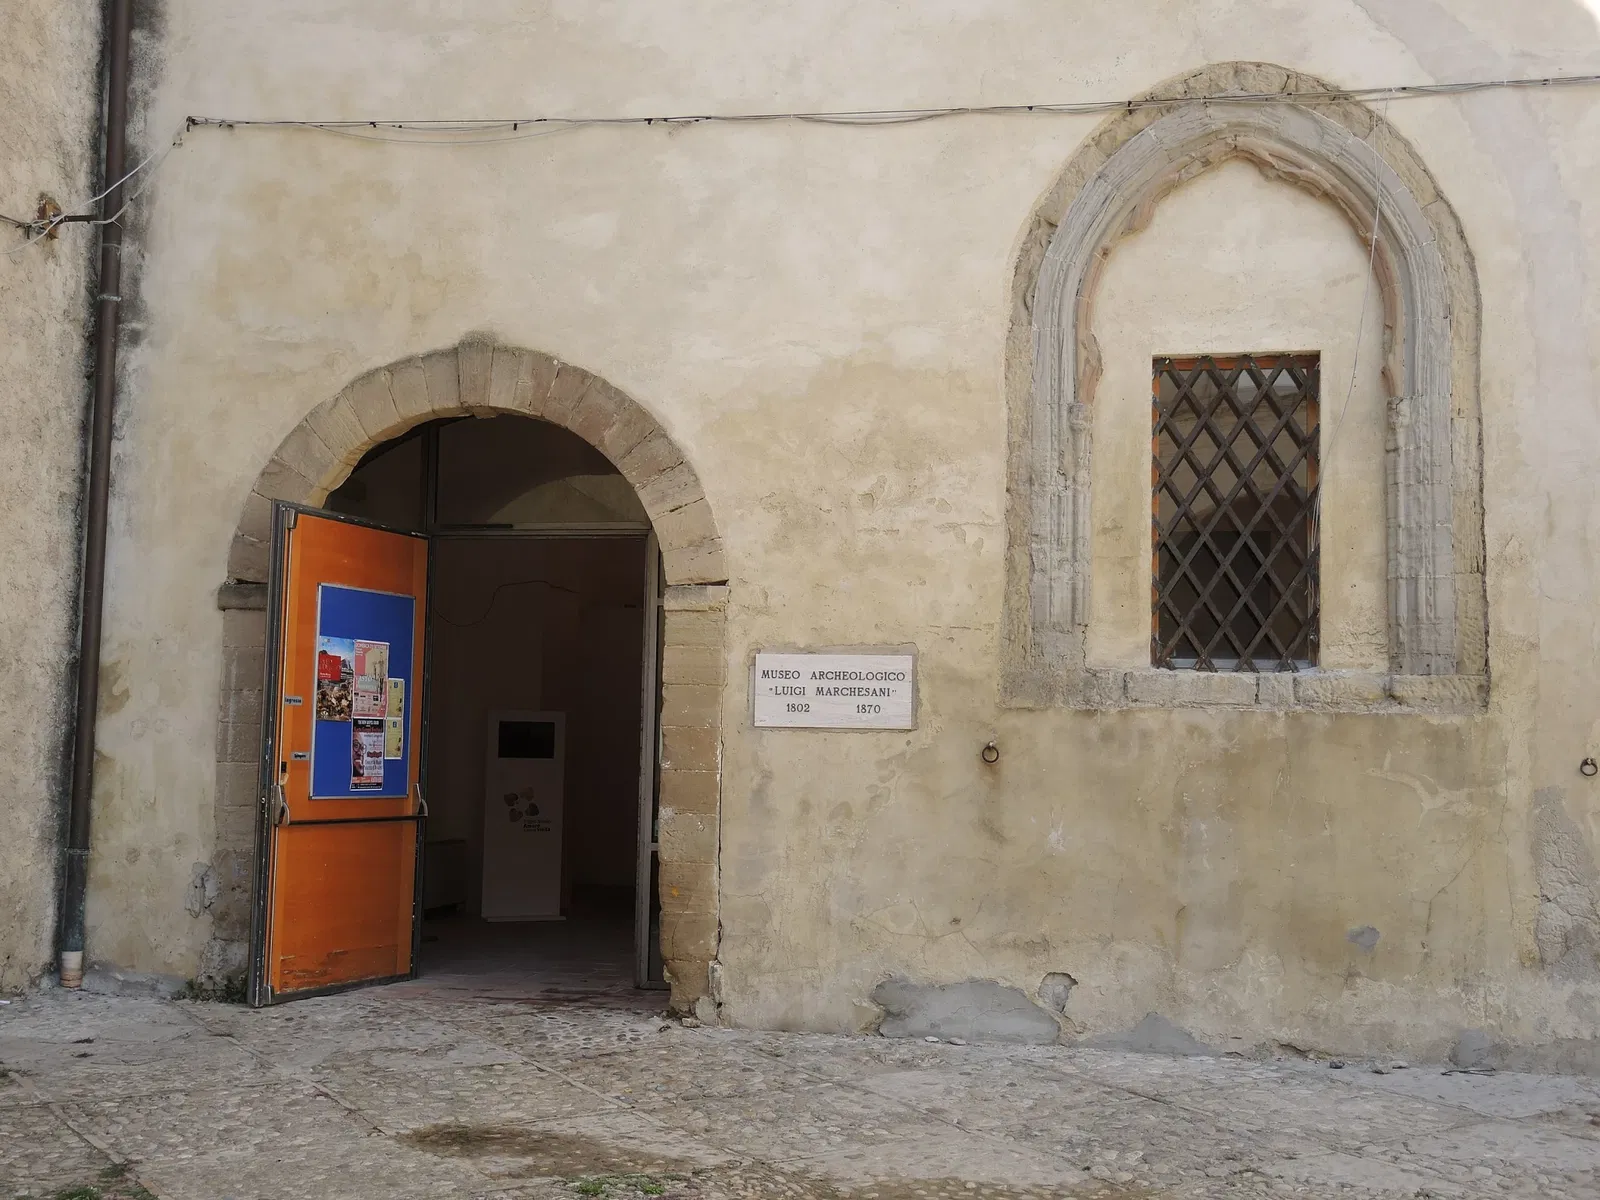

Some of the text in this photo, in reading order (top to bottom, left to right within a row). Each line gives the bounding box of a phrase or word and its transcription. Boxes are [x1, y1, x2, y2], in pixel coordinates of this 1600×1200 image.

[761, 670, 906, 682] MUSEO ARCHEOLOGICO
[786, 703, 881, 714] 1802 1870
